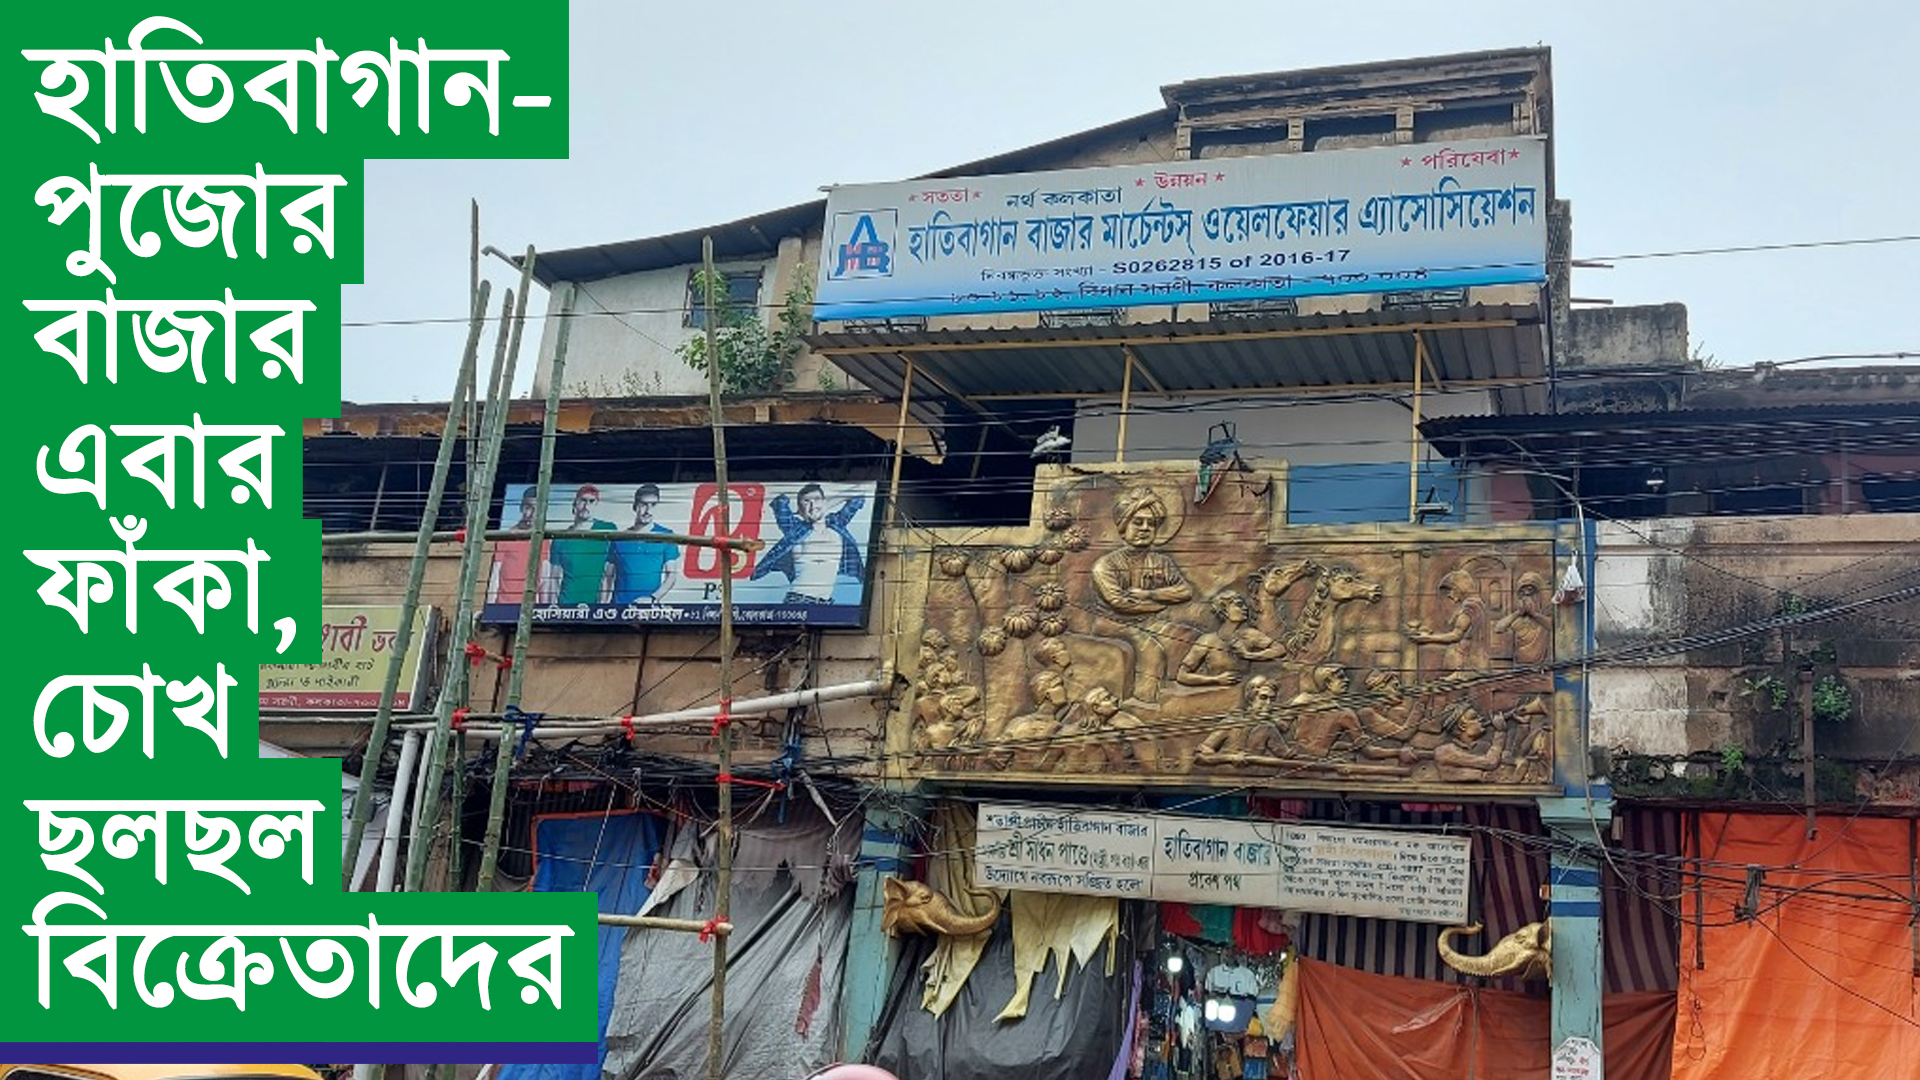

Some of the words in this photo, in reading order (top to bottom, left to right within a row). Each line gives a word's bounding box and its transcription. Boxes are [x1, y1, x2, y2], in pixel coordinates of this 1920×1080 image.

[922, 188, 968, 205] সততা
[1005, 188, 1035, 208] নর্থ
[1042, 186, 1122, 206] কলকাতা
[908, 211, 1019, 264] হাতিবাগান
[1026, 213, 1094, 253] বাজার
[1202, 198, 1350, 244] ওয়েলফেয়ার
[1112, 257, 1222, 275] S0262815
[1230, 256, 1252, 269] of
[1259, 249, 1351, 268] 2016-17
[1163, 828, 1229, 863] হাতিবাগান
[1232, 842, 1272, 867] বাজার
[1223, 873, 1242, 892] পথ
